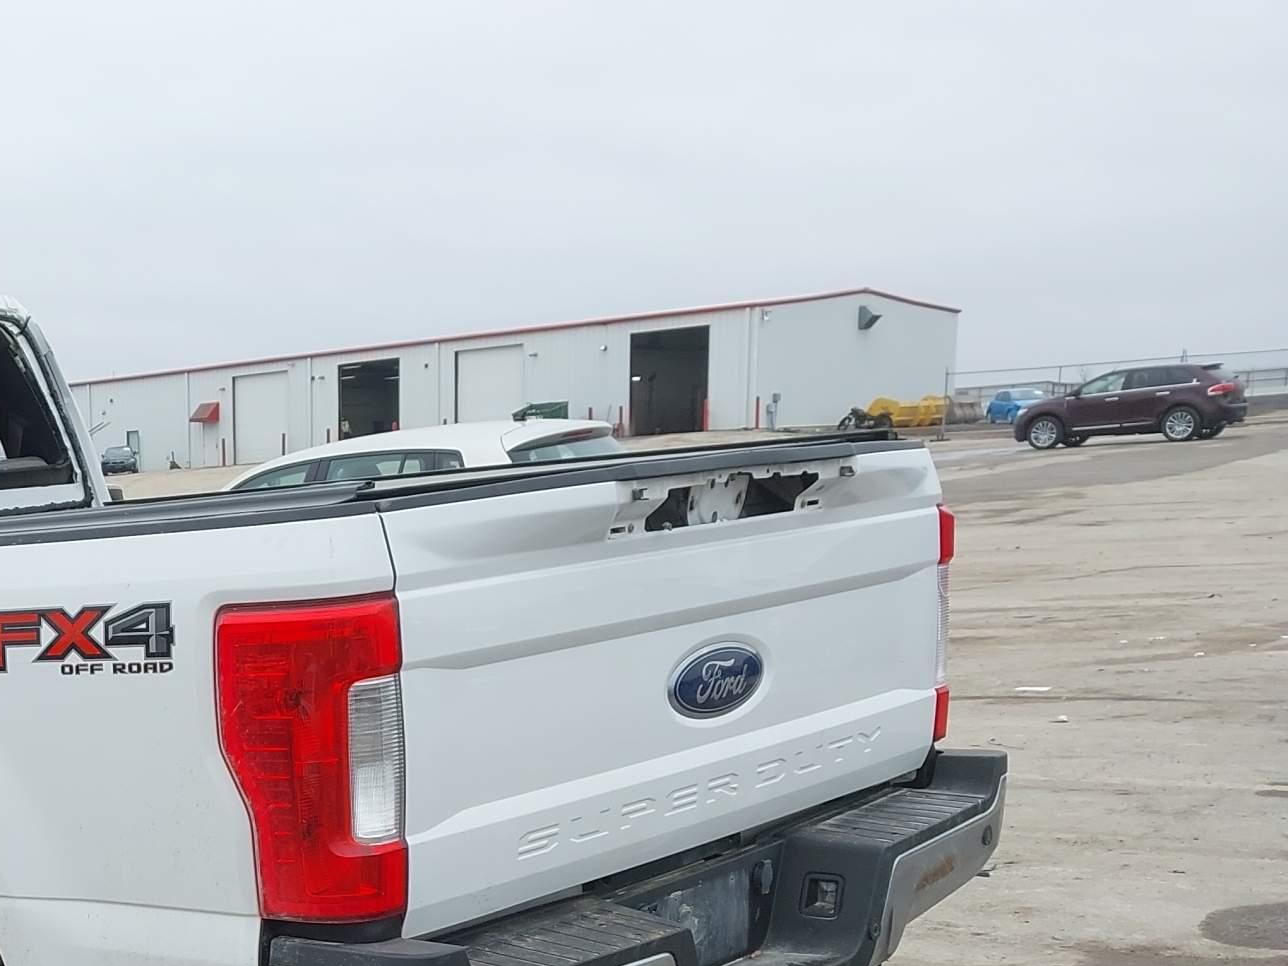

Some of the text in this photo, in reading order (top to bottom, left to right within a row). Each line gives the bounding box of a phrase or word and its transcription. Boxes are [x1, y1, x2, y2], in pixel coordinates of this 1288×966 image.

[60, 662, 174, 676] OFF ROAD
[696, 658, 748, 705] Ford
[518, 726, 882, 862] SUPER DUTY
